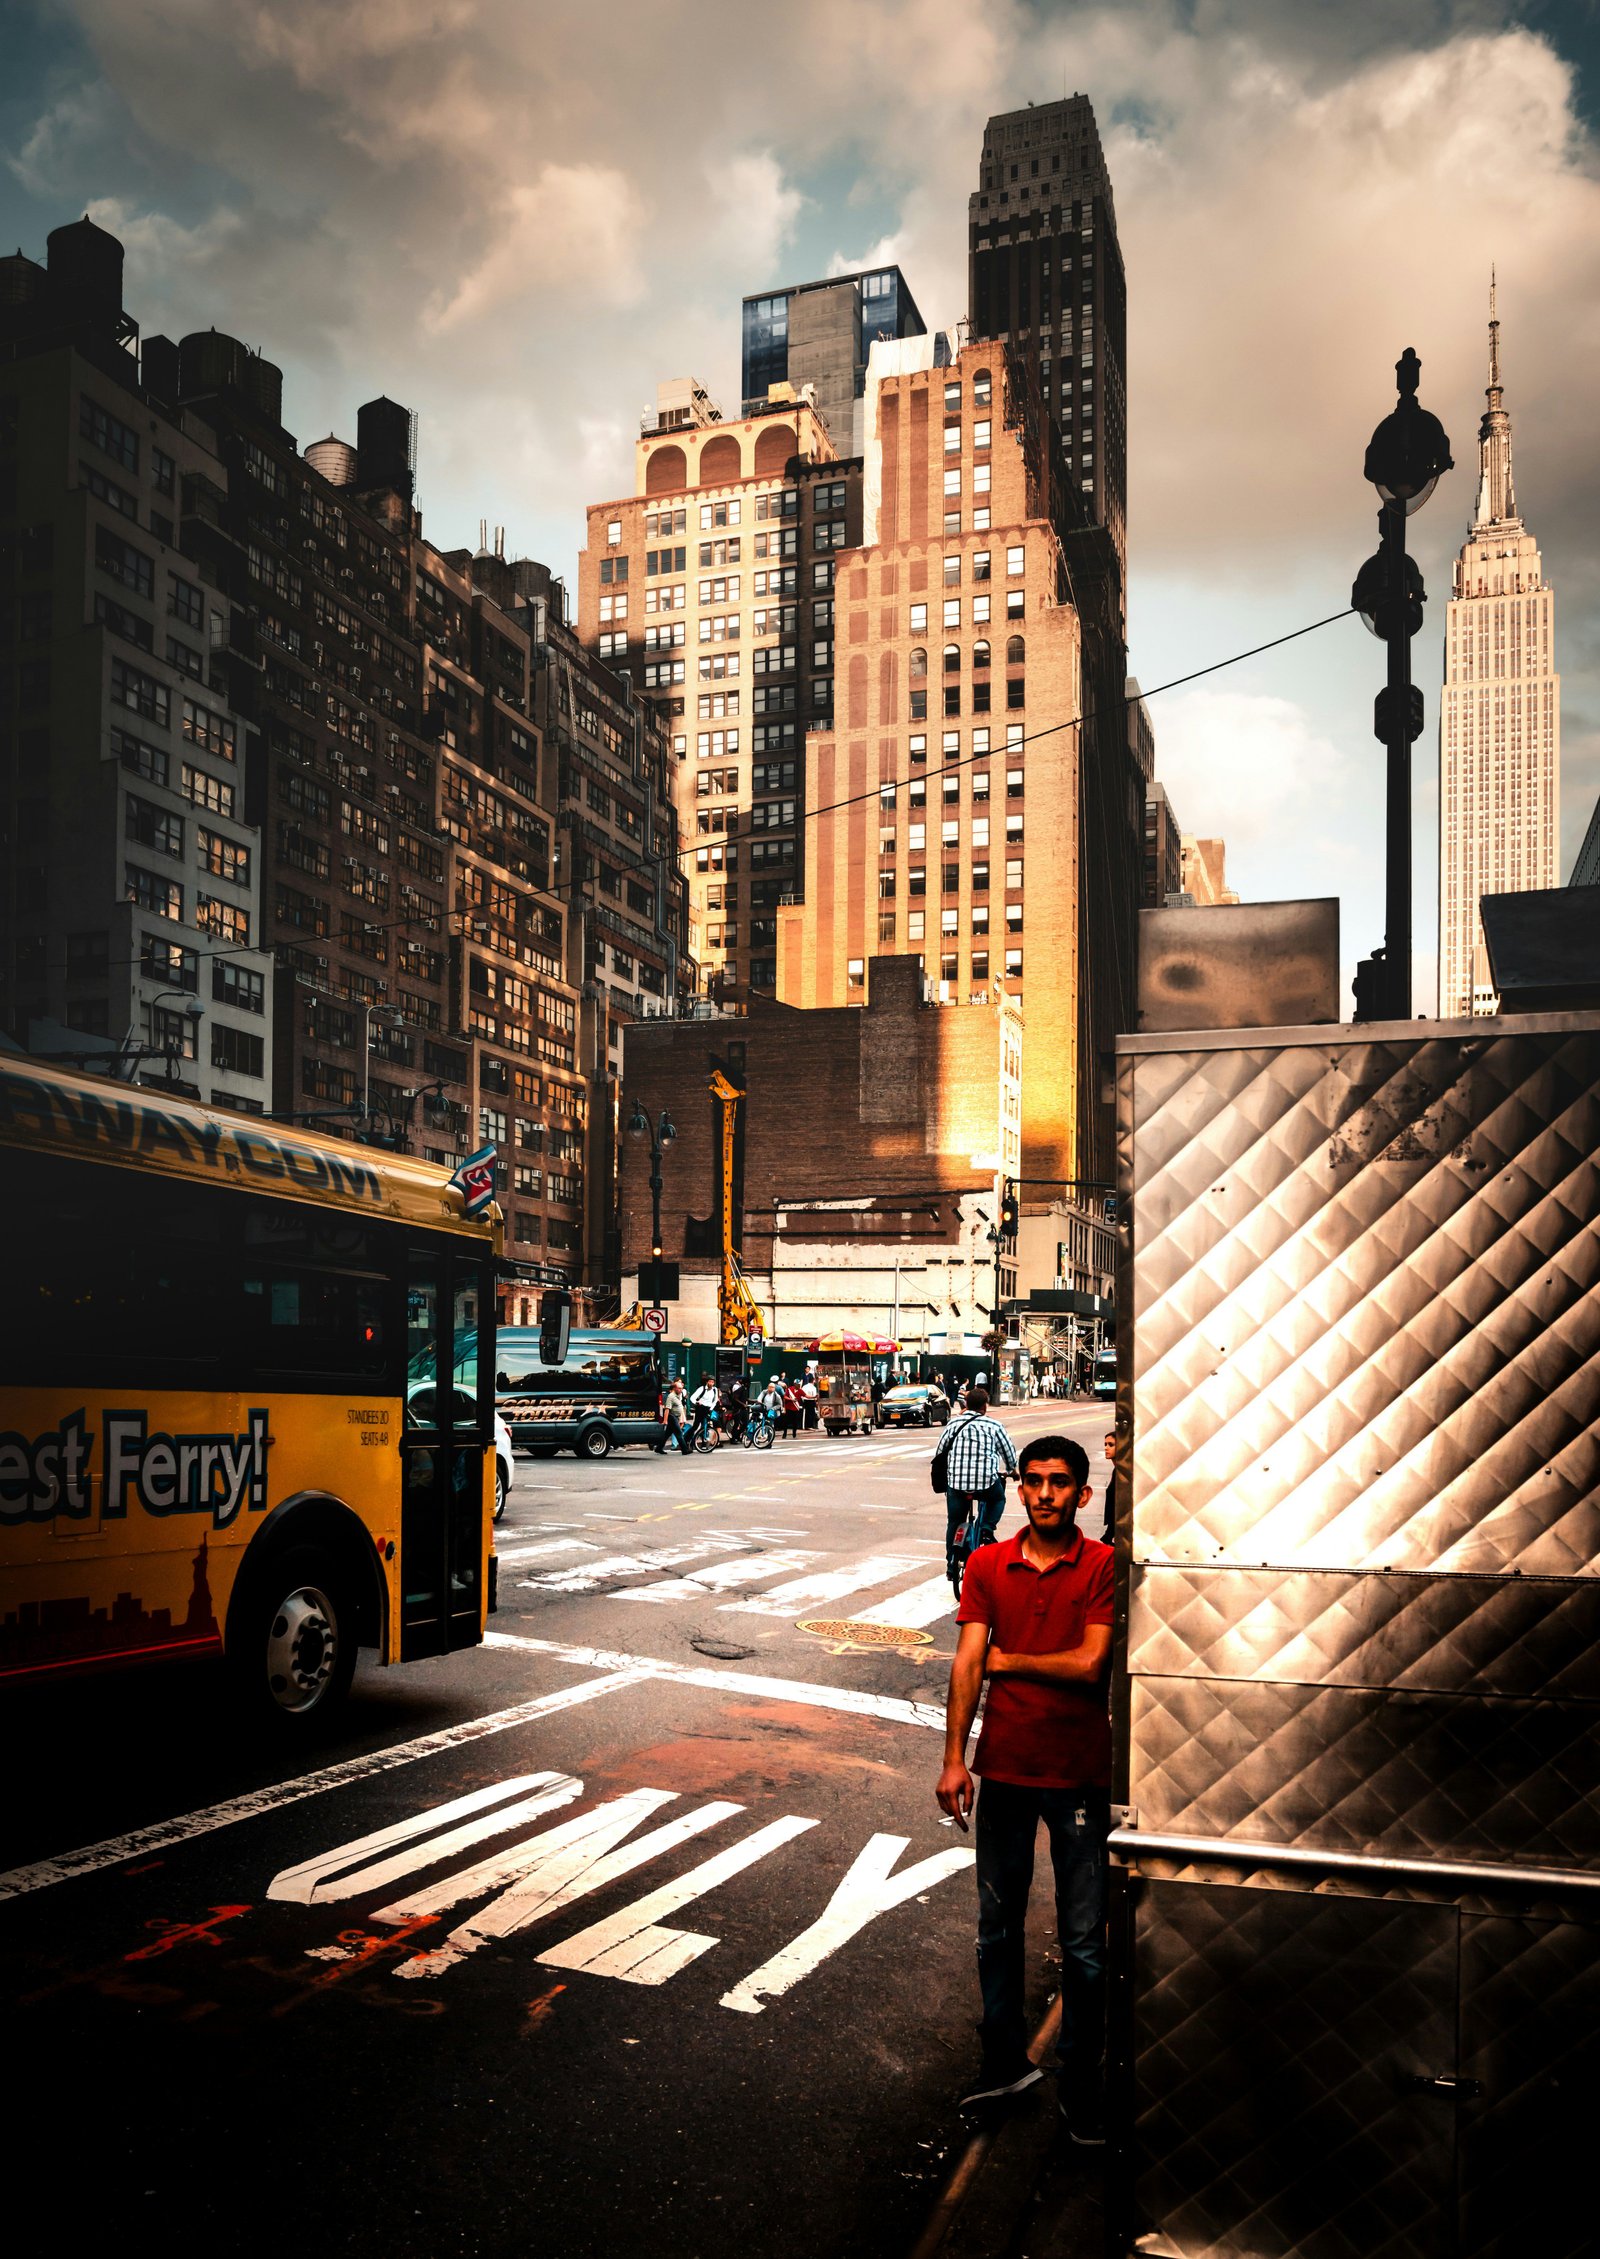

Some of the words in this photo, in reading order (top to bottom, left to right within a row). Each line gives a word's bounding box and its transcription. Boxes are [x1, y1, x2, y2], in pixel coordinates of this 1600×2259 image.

[347, 1409, 379, 1424] STANDEES
[379, 1410, 390, 1424] 20
[512, 1409, 574, 1422] TOUCH
[360, 1431, 379, 1446] SEATS
[380, 1431, 389, 1446] 48
[104, 1412, 267, 1525] Ferry!
[265, 1769, 977, 2014] ONLY
